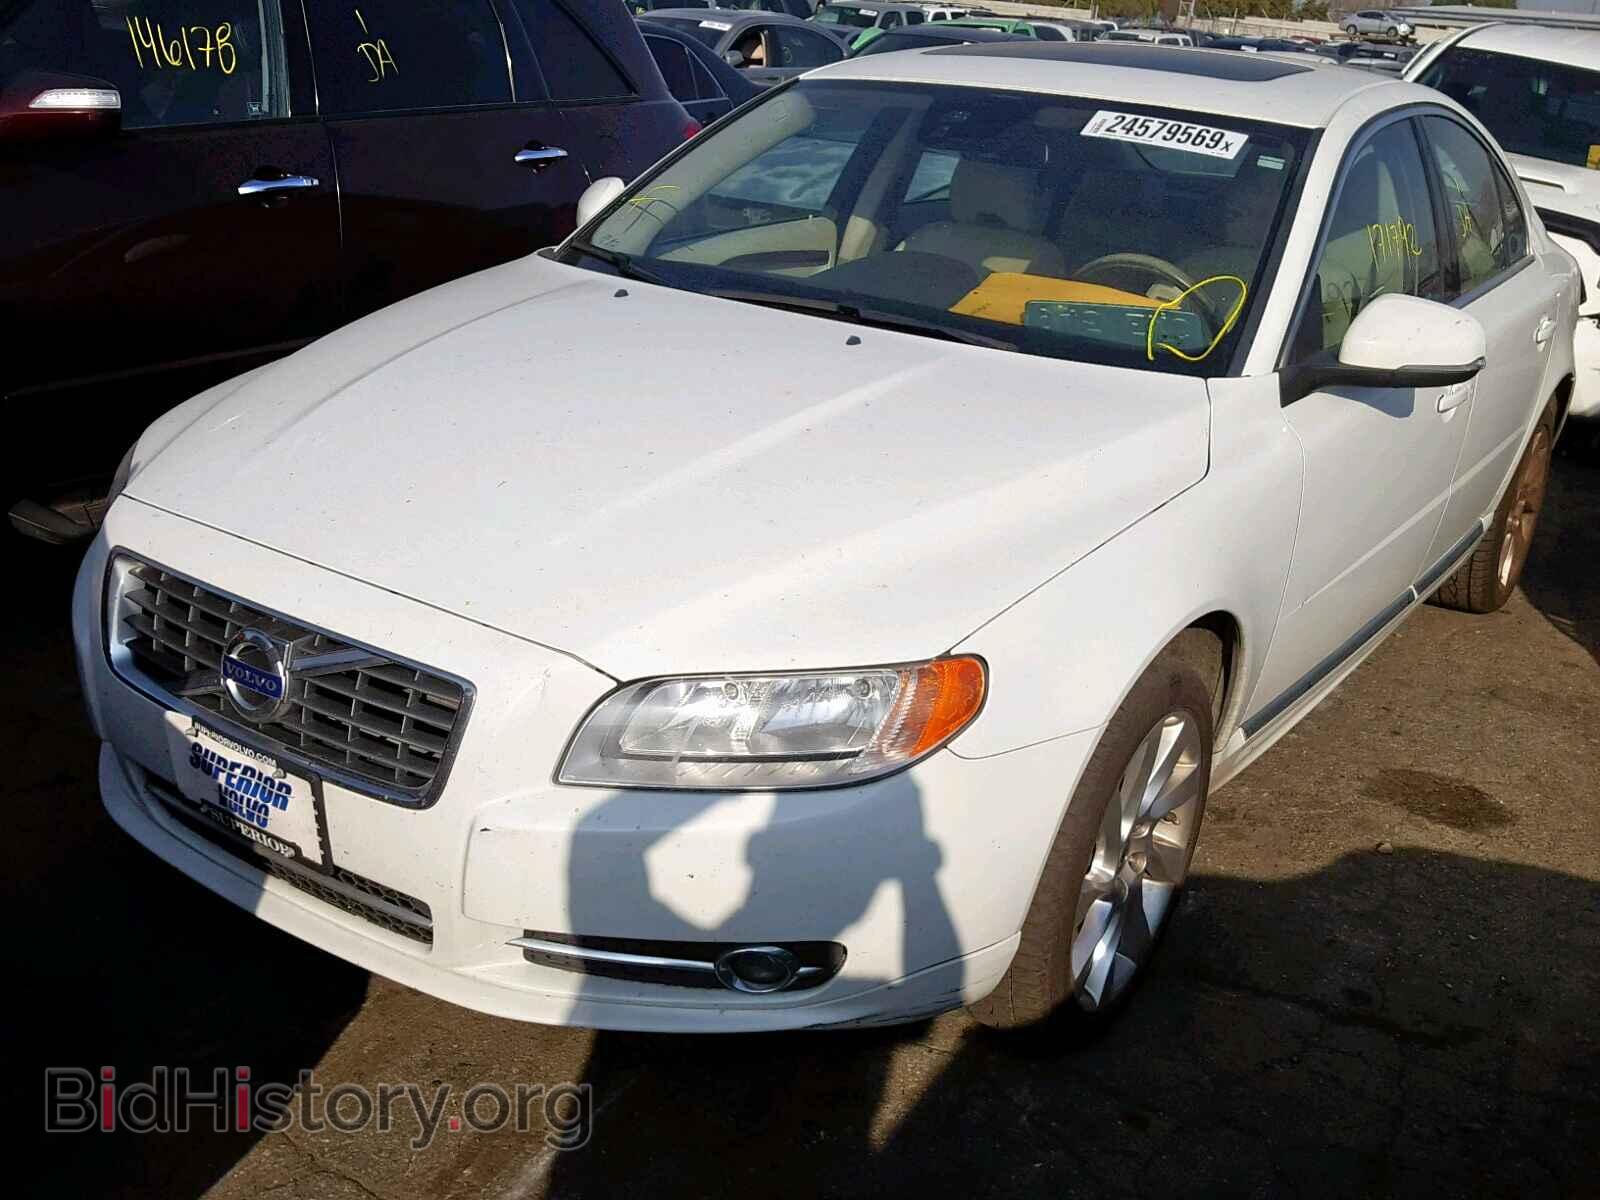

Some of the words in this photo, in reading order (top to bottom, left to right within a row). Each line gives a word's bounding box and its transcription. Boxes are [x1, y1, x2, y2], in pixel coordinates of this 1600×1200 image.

[126, 16, 236, 74] 146178
[224, 660, 278, 692] VOLVO
[190, 742, 293, 812] SUPERIOR
[219, 783, 271, 829] VOLVO
